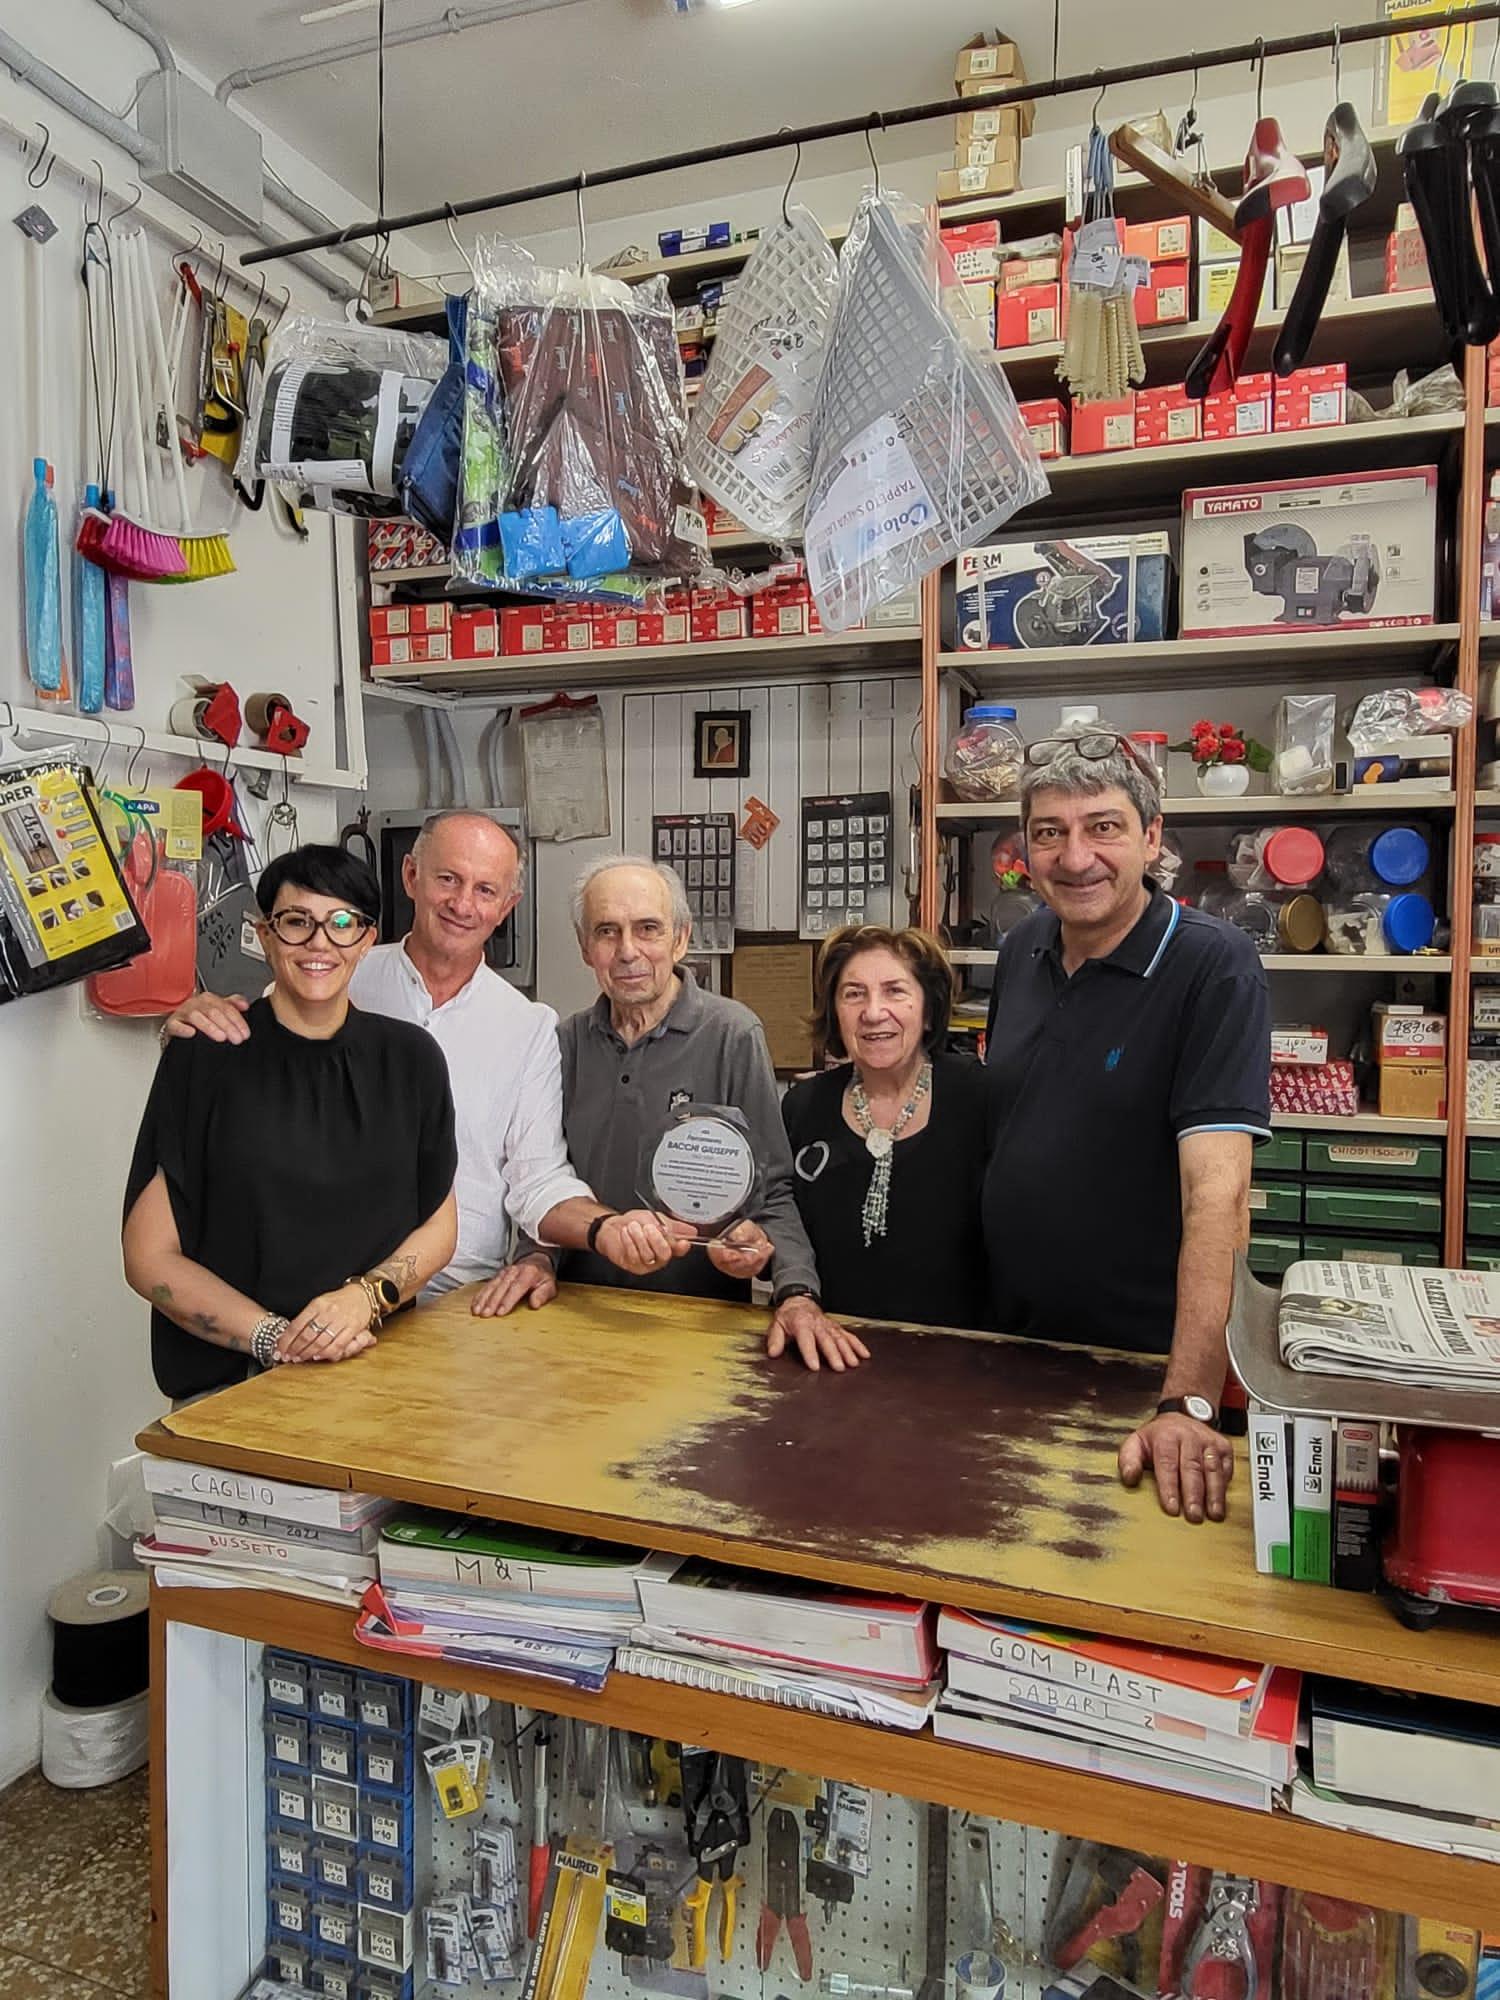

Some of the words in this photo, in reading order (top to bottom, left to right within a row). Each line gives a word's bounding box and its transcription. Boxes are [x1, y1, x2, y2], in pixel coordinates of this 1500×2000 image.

[867, 503, 928, 541] Colore
[1207, 499, 1260, 513] YAMATO
[963, 551, 1002, 571] FERM
[667, 1141, 700, 1152] BACCHI
[701, 1145, 740, 1157] GIUSEPPE
[1309, 1436, 1324, 1475] Emak
[191, 1473, 274, 1506] CAGLIO
[1257, 1455, 1276, 1501] Emak
[208, 1535, 289, 1558] BUSSETO
[454, 1555, 483, 1585] M
[494, 1557, 513, 1581] &
[516, 1565, 548, 1593] T
[989, 1636, 1052, 1673] GOM
[1073, 1660, 1164, 1704] PLAST
[557, 1854, 599, 1876] MAURER
[1168, 1869, 1187, 1920] TOOLS
[531, 1946, 544, 1977] mano
[538, 1911, 551, 1944] curva
